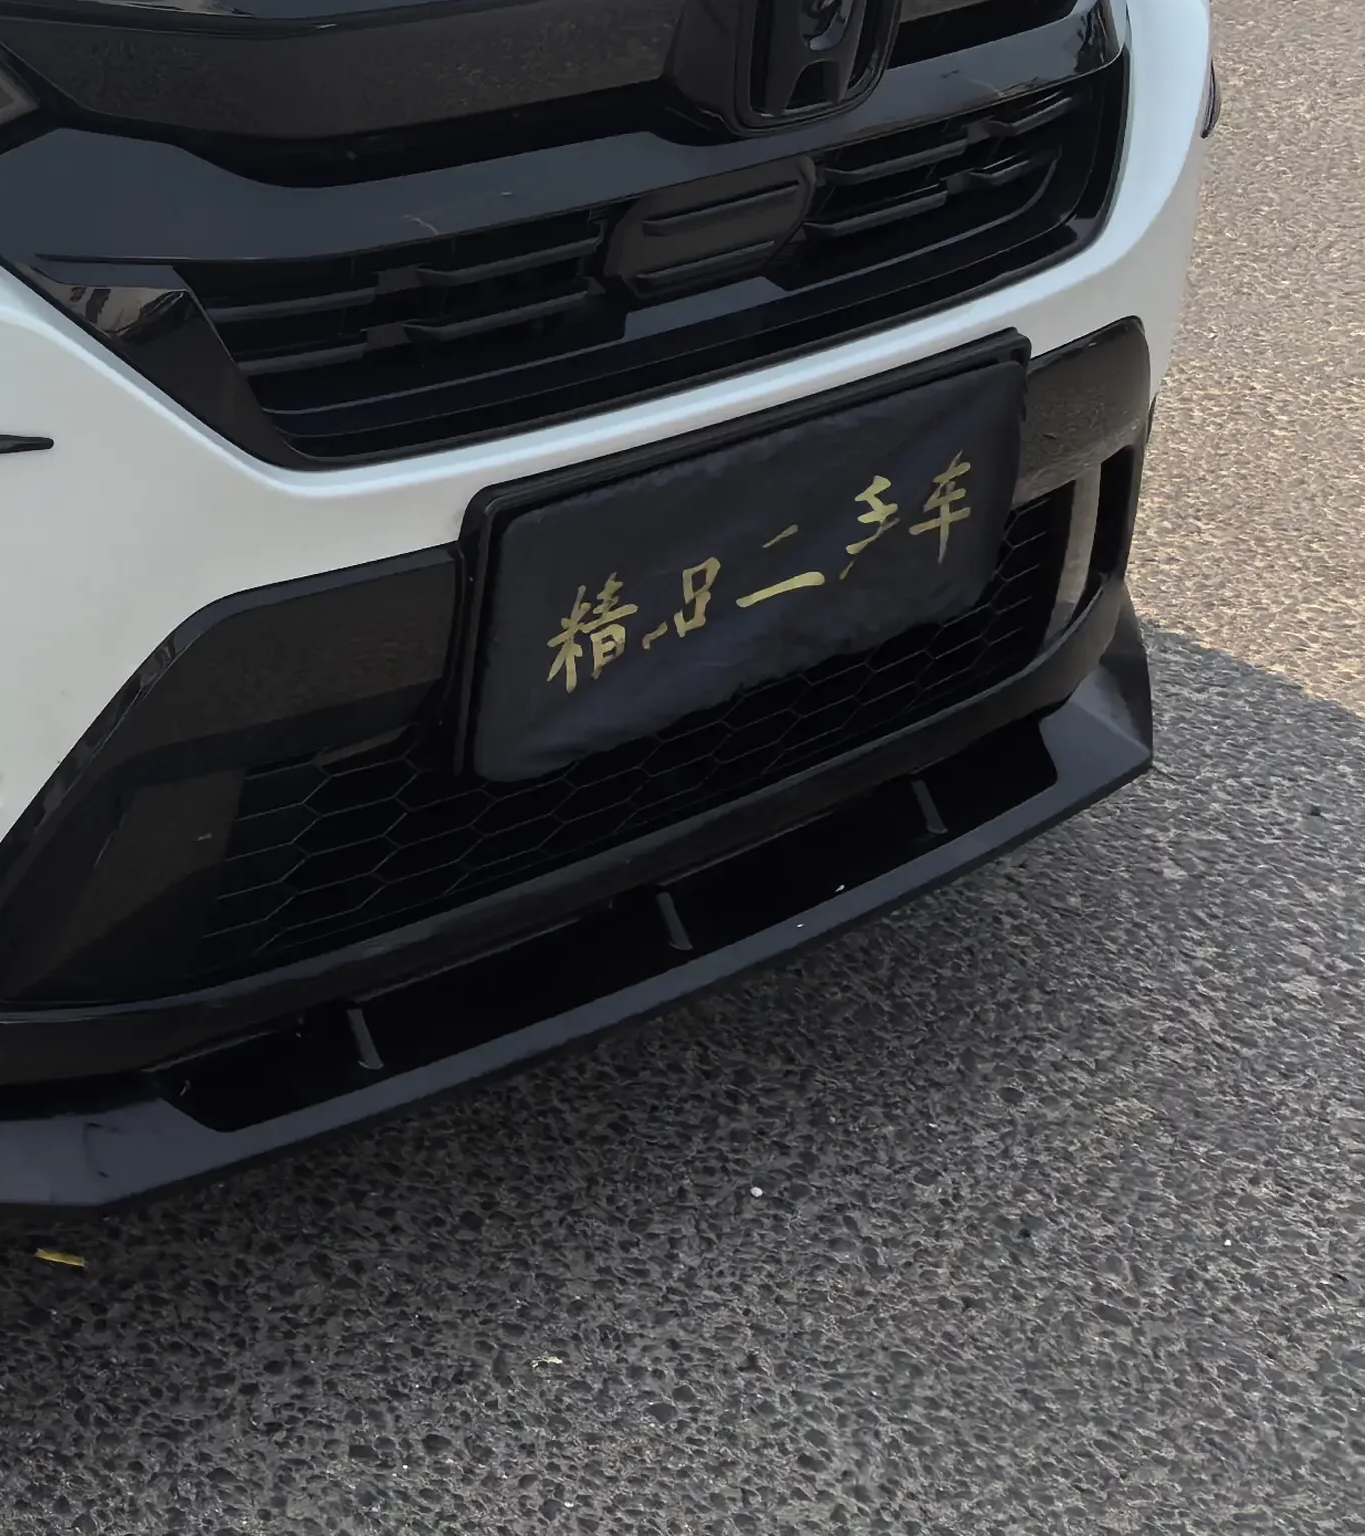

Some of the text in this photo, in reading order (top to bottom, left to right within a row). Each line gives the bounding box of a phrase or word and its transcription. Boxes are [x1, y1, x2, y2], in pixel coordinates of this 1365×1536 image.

[546, 451, 971, 692] 精品二手车
